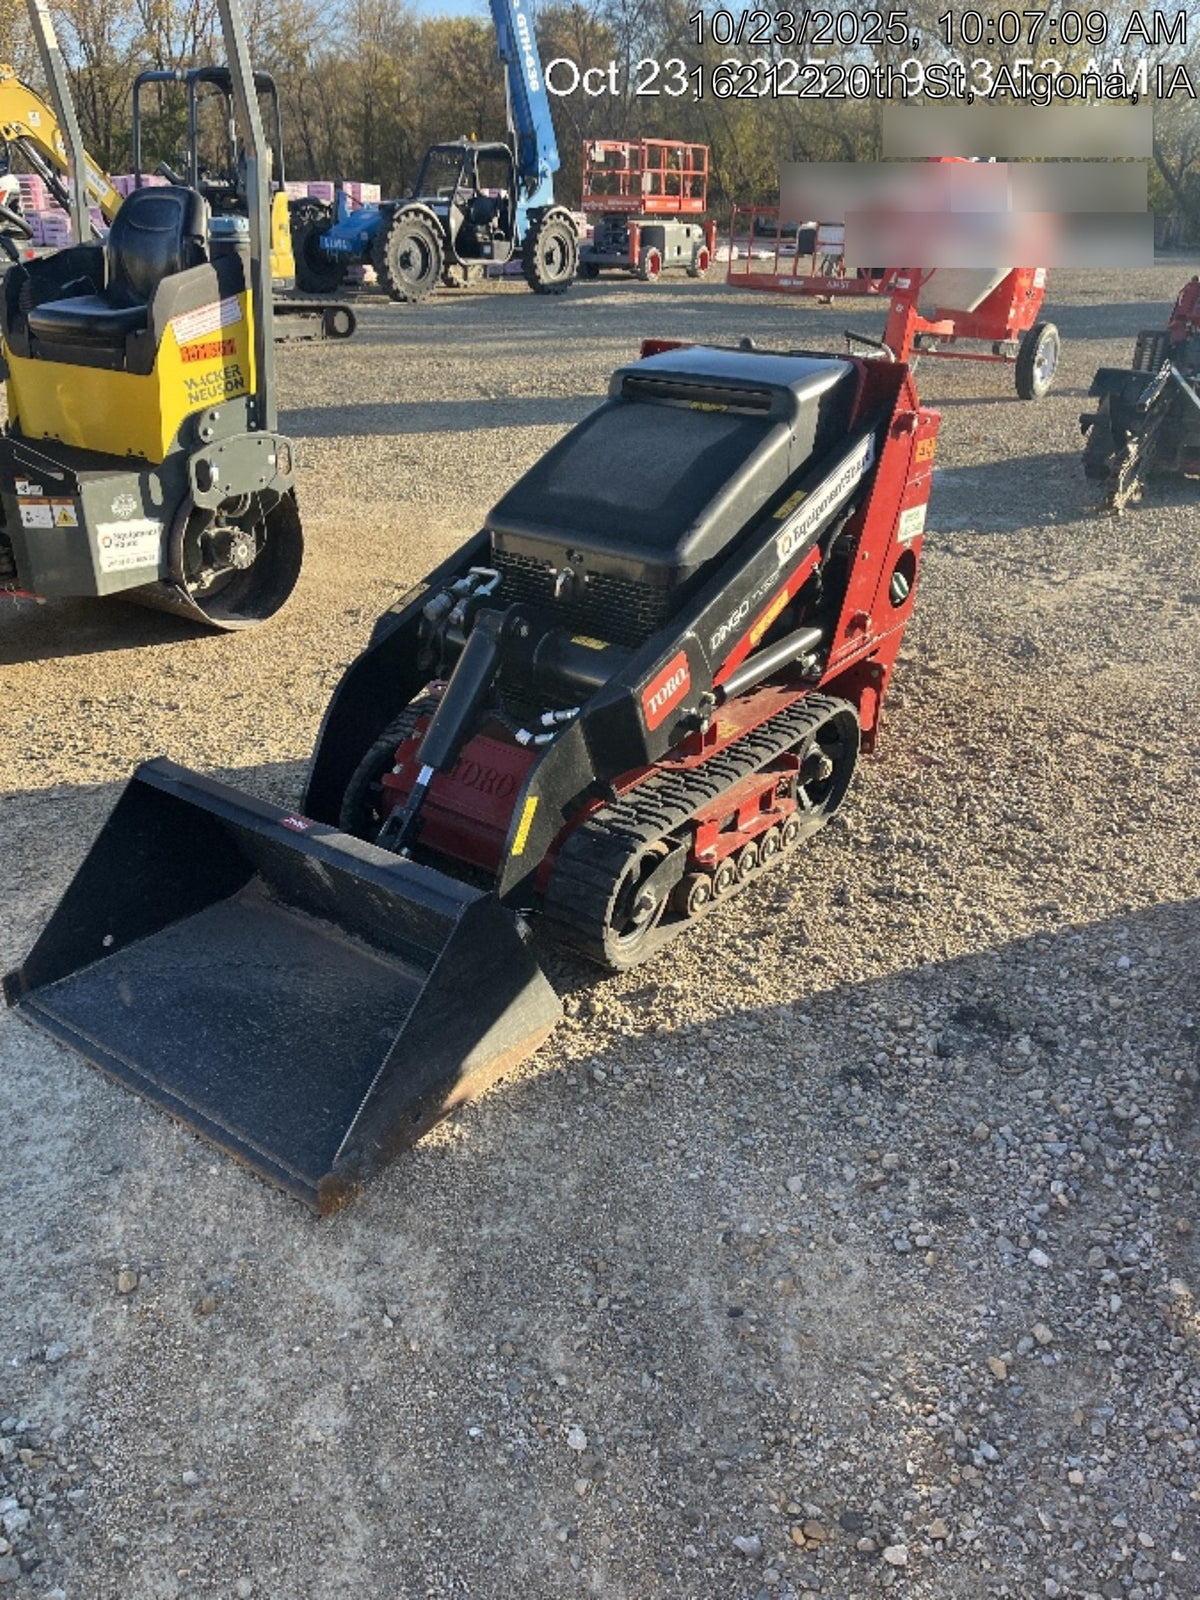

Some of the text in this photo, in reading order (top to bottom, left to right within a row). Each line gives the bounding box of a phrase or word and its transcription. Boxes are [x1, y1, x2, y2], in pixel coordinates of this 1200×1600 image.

[183, 363, 242, 391] WACKER
[187, 376, 246, 405] NEUSON
[646, 667, 687, 716] TORO
